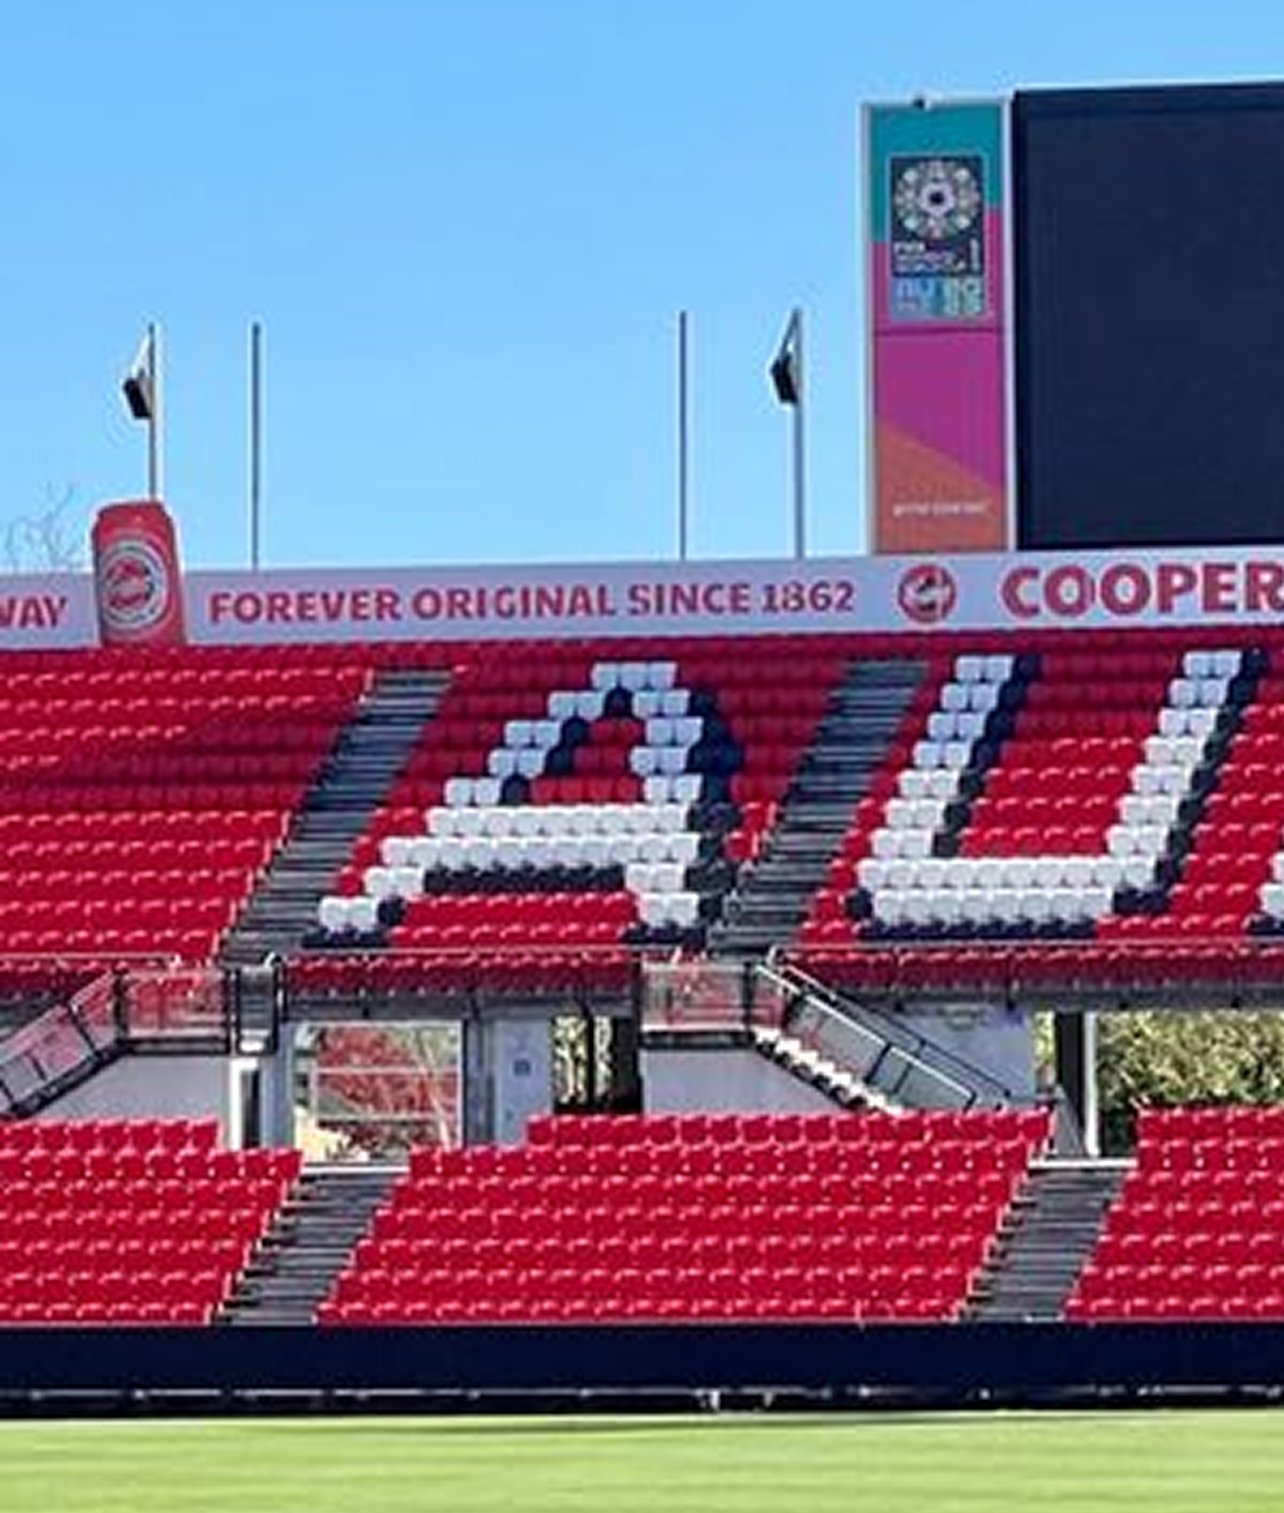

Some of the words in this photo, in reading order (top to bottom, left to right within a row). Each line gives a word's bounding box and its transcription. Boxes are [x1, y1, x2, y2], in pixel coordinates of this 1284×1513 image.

[208, 589, 400, 625] FOREVER
[411, 583, 617, 622] ORIGINAL
[626, 583, 751, 619] SINCE
[760, 580, 856, 616] 1862
